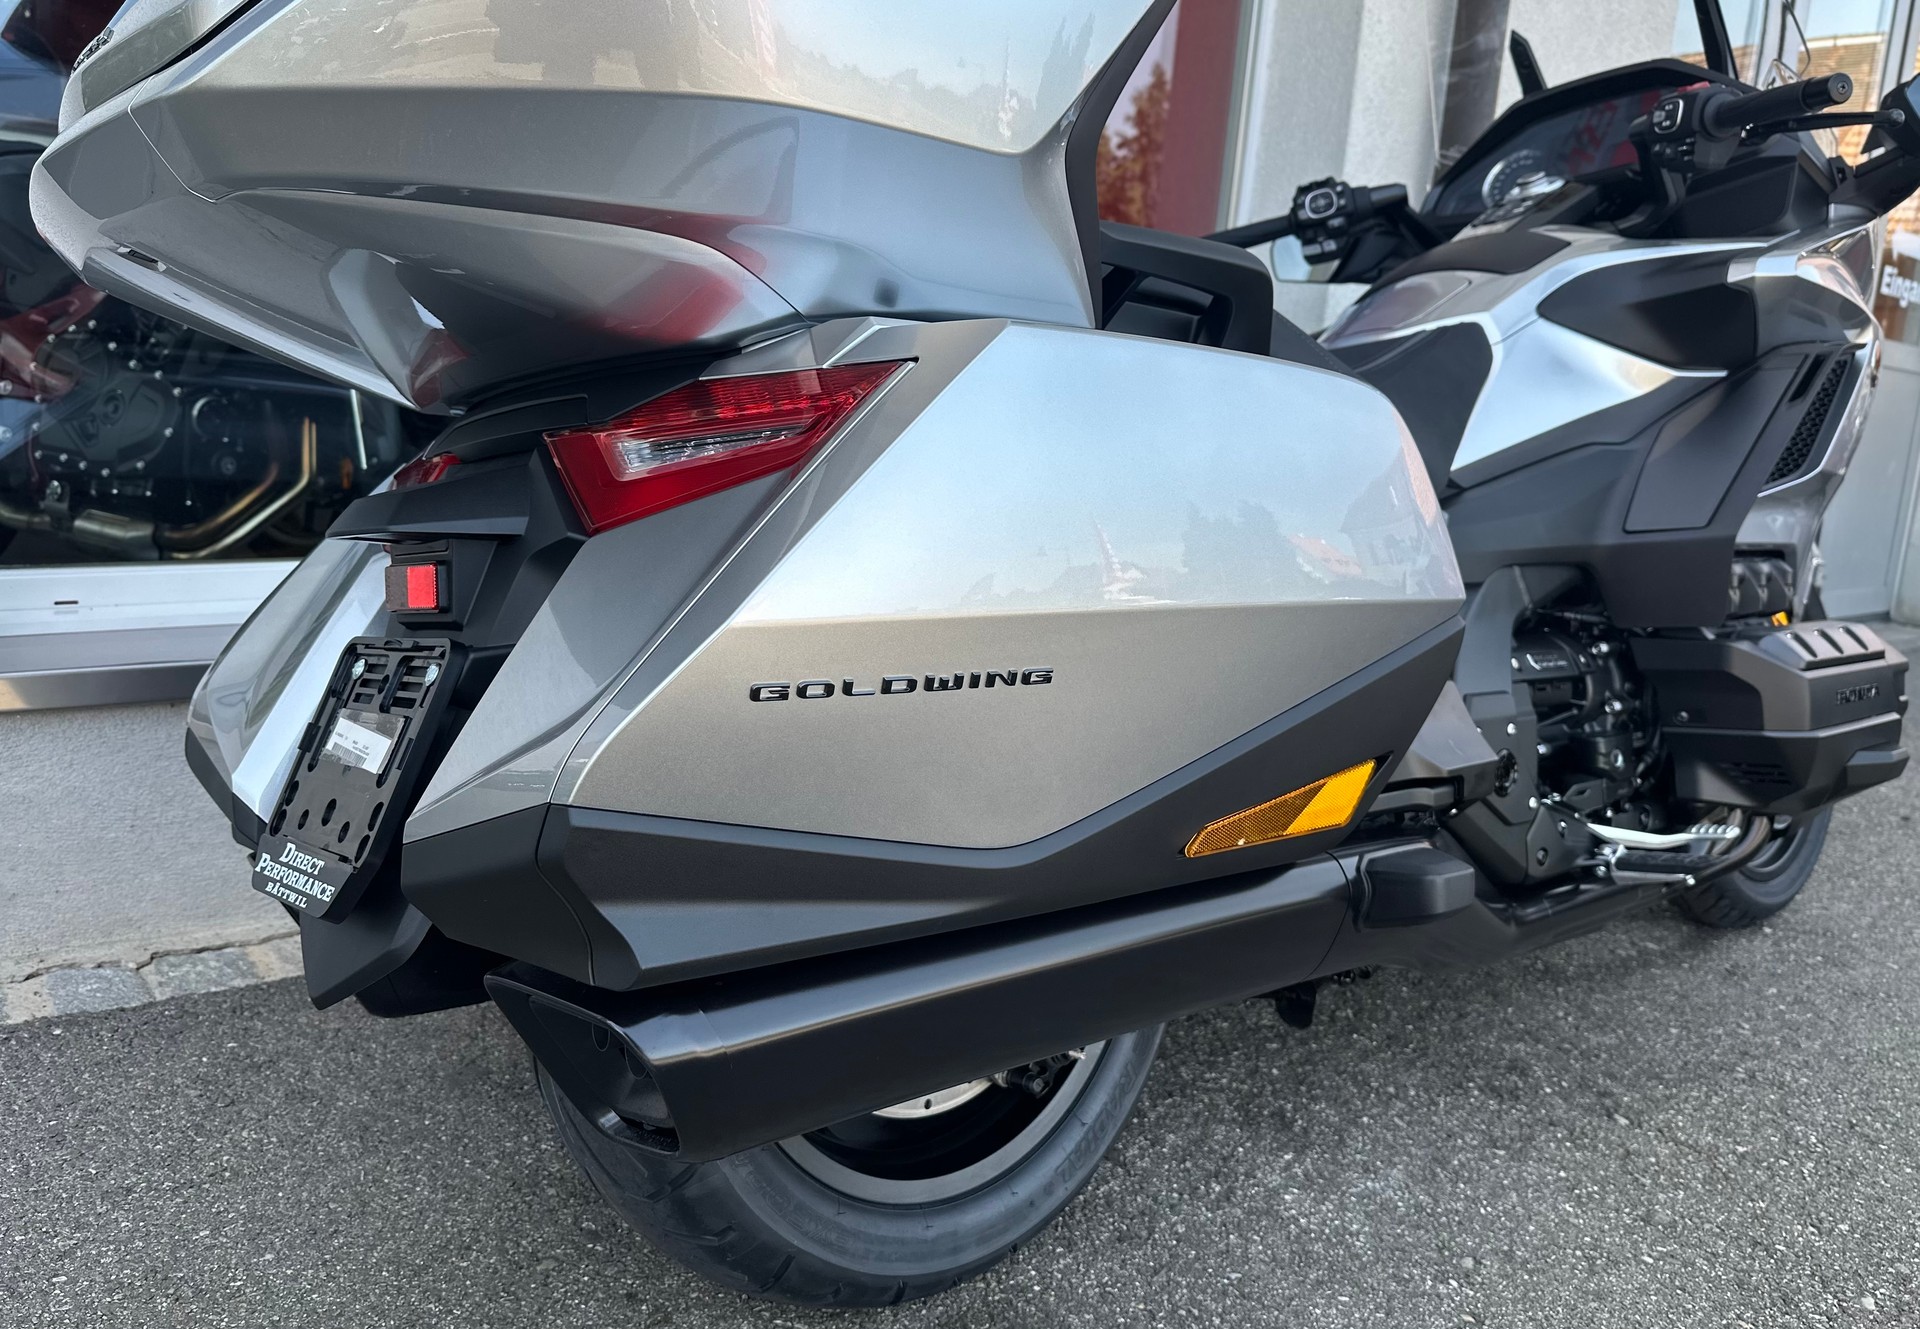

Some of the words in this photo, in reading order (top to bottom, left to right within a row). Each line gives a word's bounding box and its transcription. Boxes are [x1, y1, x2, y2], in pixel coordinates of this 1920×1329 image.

[749, 667, 1054, 702] GOLDWING
[279, 842, 326, 875] DIRECT
[255, 852, 336, 902] PERFORMANCE
